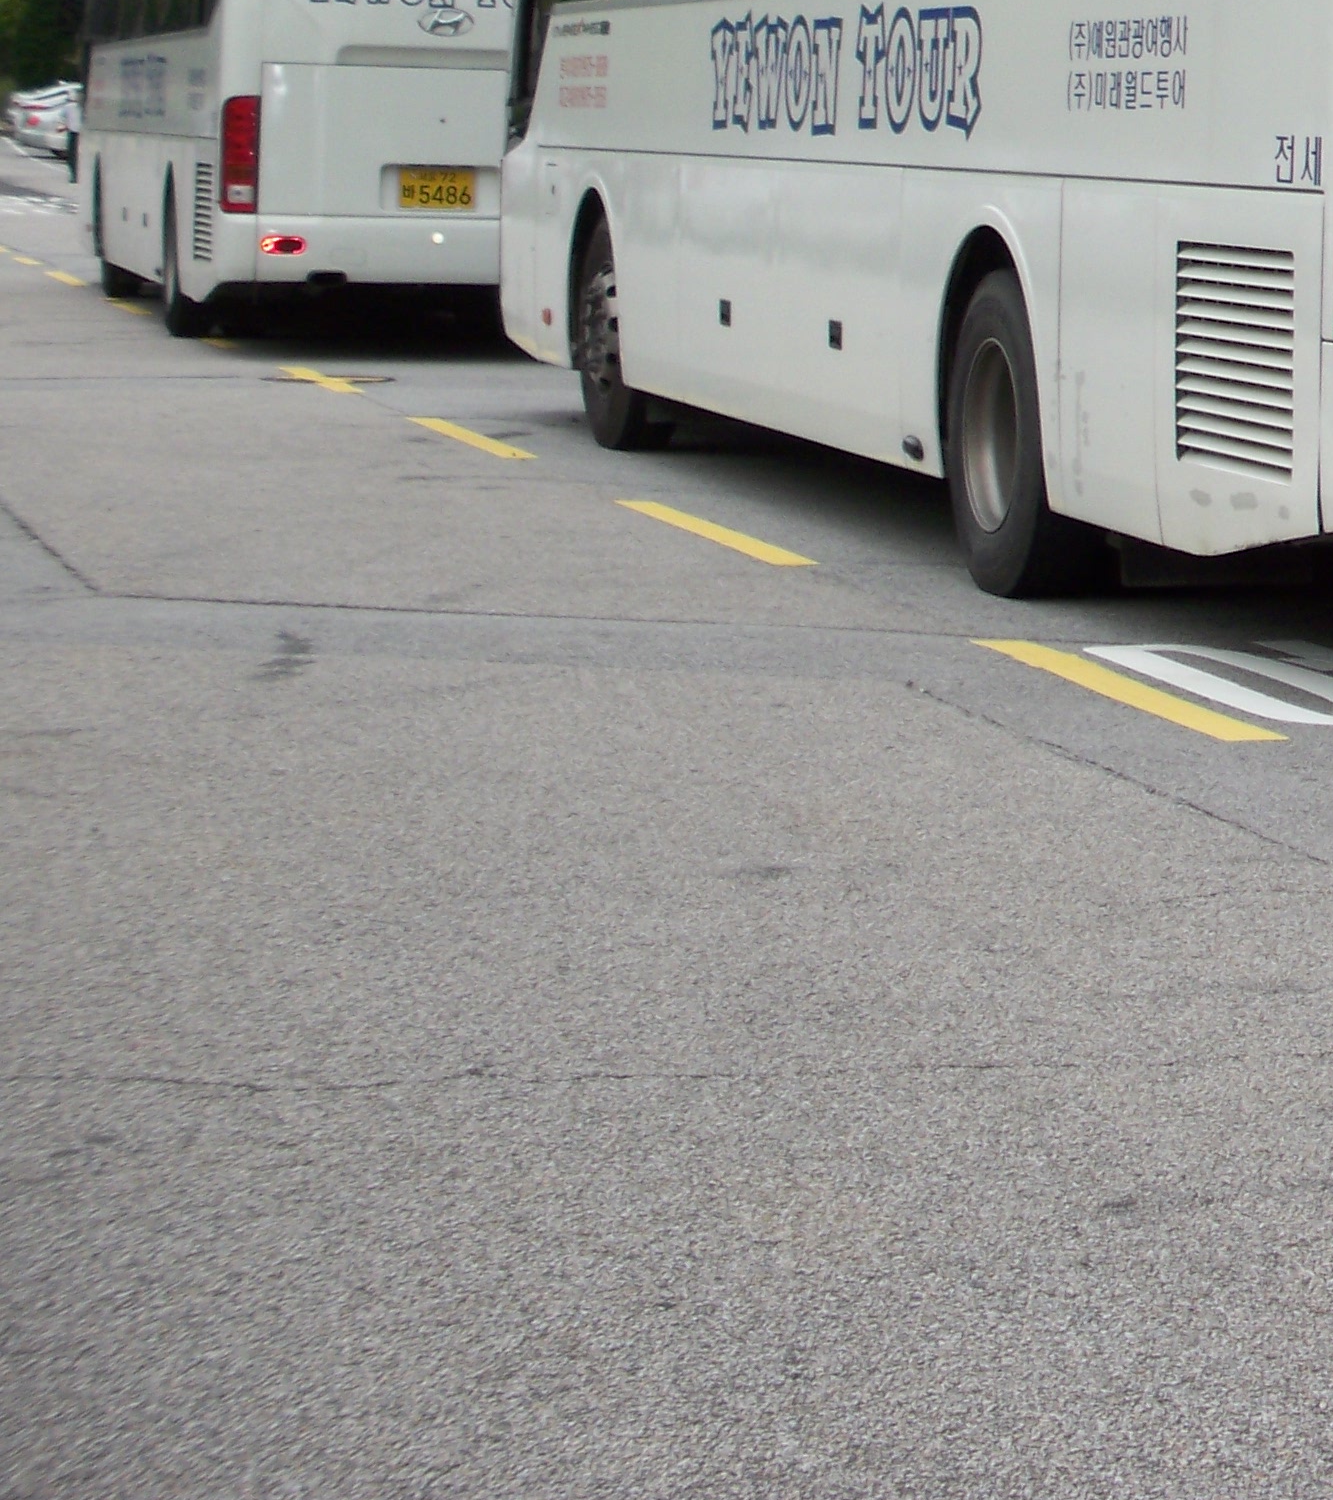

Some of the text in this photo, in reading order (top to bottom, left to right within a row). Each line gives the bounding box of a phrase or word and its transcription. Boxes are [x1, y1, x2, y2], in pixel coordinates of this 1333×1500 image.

[1068, 14, 1188, 61] (주)예원관광여행사
[710, 2, 983, 142] YEWON TOUR
[1066, 68, 1187, 112] (주)미래월드투어
[1274, 134, 1323, 186] 전세
[419, 184, 472, 205] 5486
